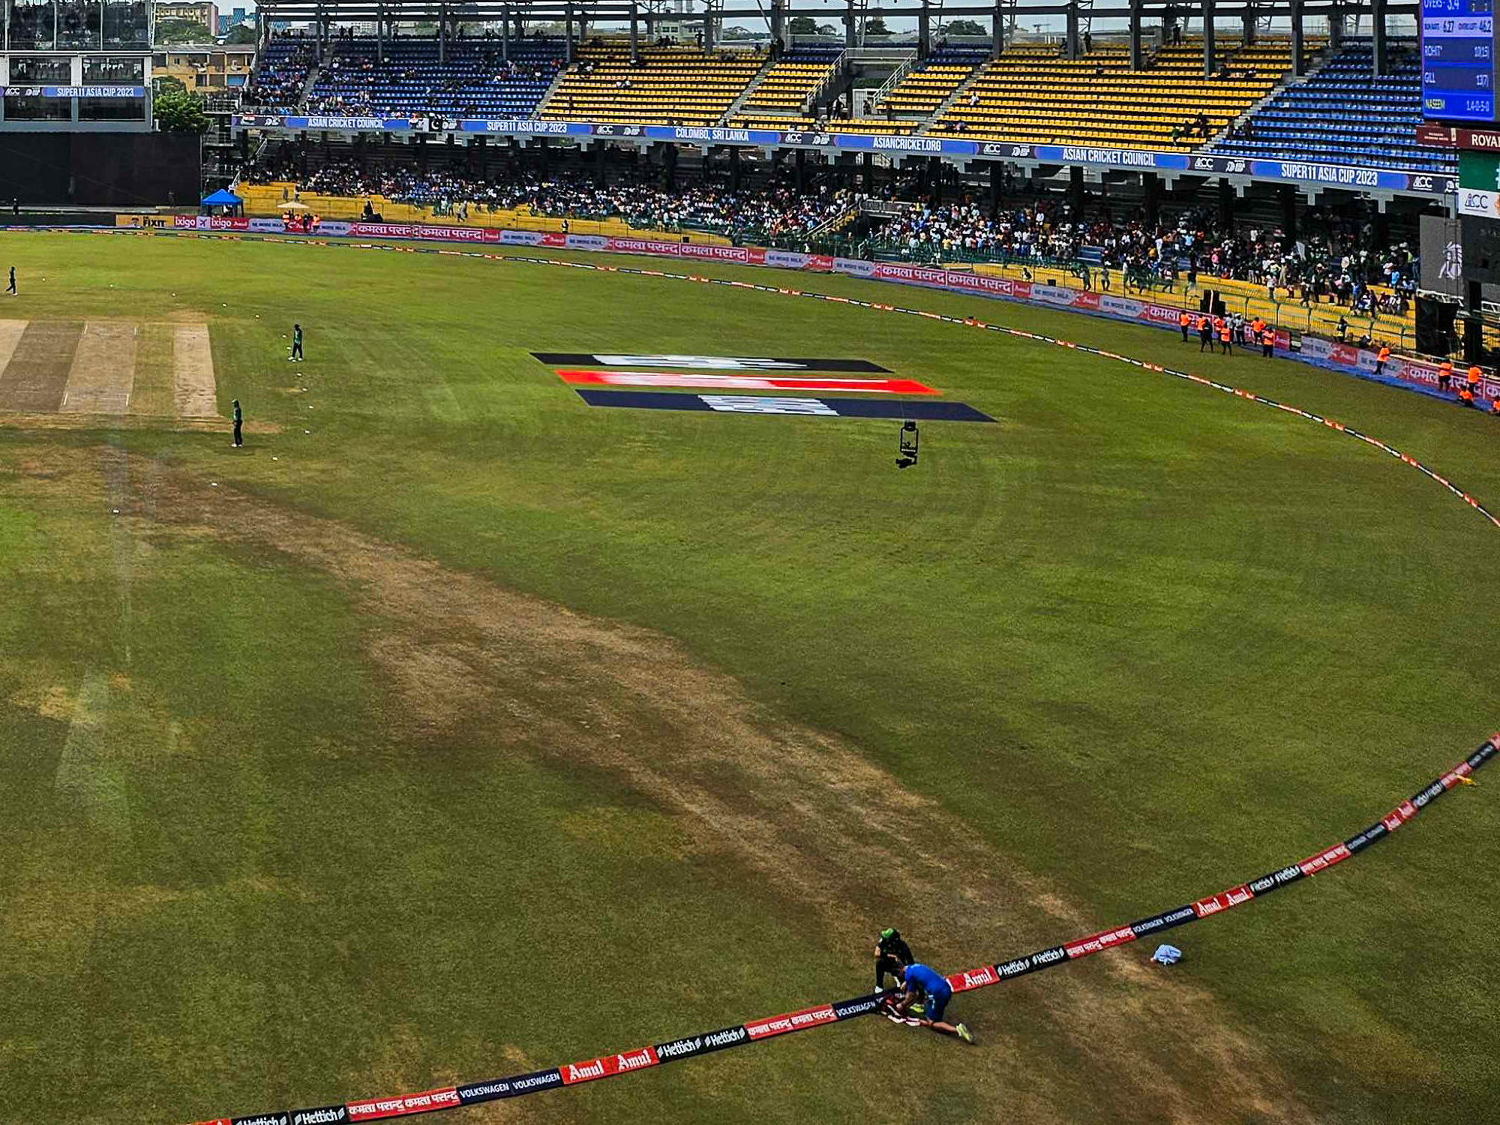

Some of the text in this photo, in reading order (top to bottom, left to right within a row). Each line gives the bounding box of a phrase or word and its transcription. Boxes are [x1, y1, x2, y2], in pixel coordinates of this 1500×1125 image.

[86, 87, 101, 96] ASIA
[103, 87, 116, 96] CUP
[117, 87, 134, 96] 2023
[308, 118, 384, 129] ASIAN CRICKET COUNCIL
[517, 122, 533, 132] ASIA
[534, 122, 548, 132] CUP
[549, 123, 567, 133] 2023
[676, 128, 749, 141] COLOMBO, SRI LANKA
[873, 137, 941, 152] ASIANCRICKET.ORG
[1063, 148, 1156, 167] ASIAN CRICKET COUNCIL
[1281, 164, 1378, 186] SUPER11 ASIA CUP 2023
[143, 218, 167, 228] FIXIT
[175, 216, 196, 228] ixigo
[211, 217, 232, 229] ixigo
[358, 225, 387, 236] कमला
[421, 228, 451, 239] कमला
[614, 240, 645, 251] कमला
[681, 245, 713, 256] कमला
[882, 265, 914, 278] कमला
[948, 274, 979, 287] कमला
[1226, 888, 1249, 907] Amul
[1197, 897, 1221, 917] Amul
[1036, 948, 1061, 965] Hettich
[1001, 959, 1026, 976] Hettich
[964, 969, 992, 988] Amul
[837, 1001, 876, 1018] VOLKSWAGEN
[710, 1028, 741, 1048] Hettich
[664, 1040, 697, 1058] Hettich
[618, 1049, 653, 1071] Amul
[570, 1059, 605, 1082] Amul
[512, 1073, 560, 1091] VOLKSWAGEN
[460, 1082, 510, 1099] VOLKSWAGEN
[303, 1109, 338, 1125] Hettich
